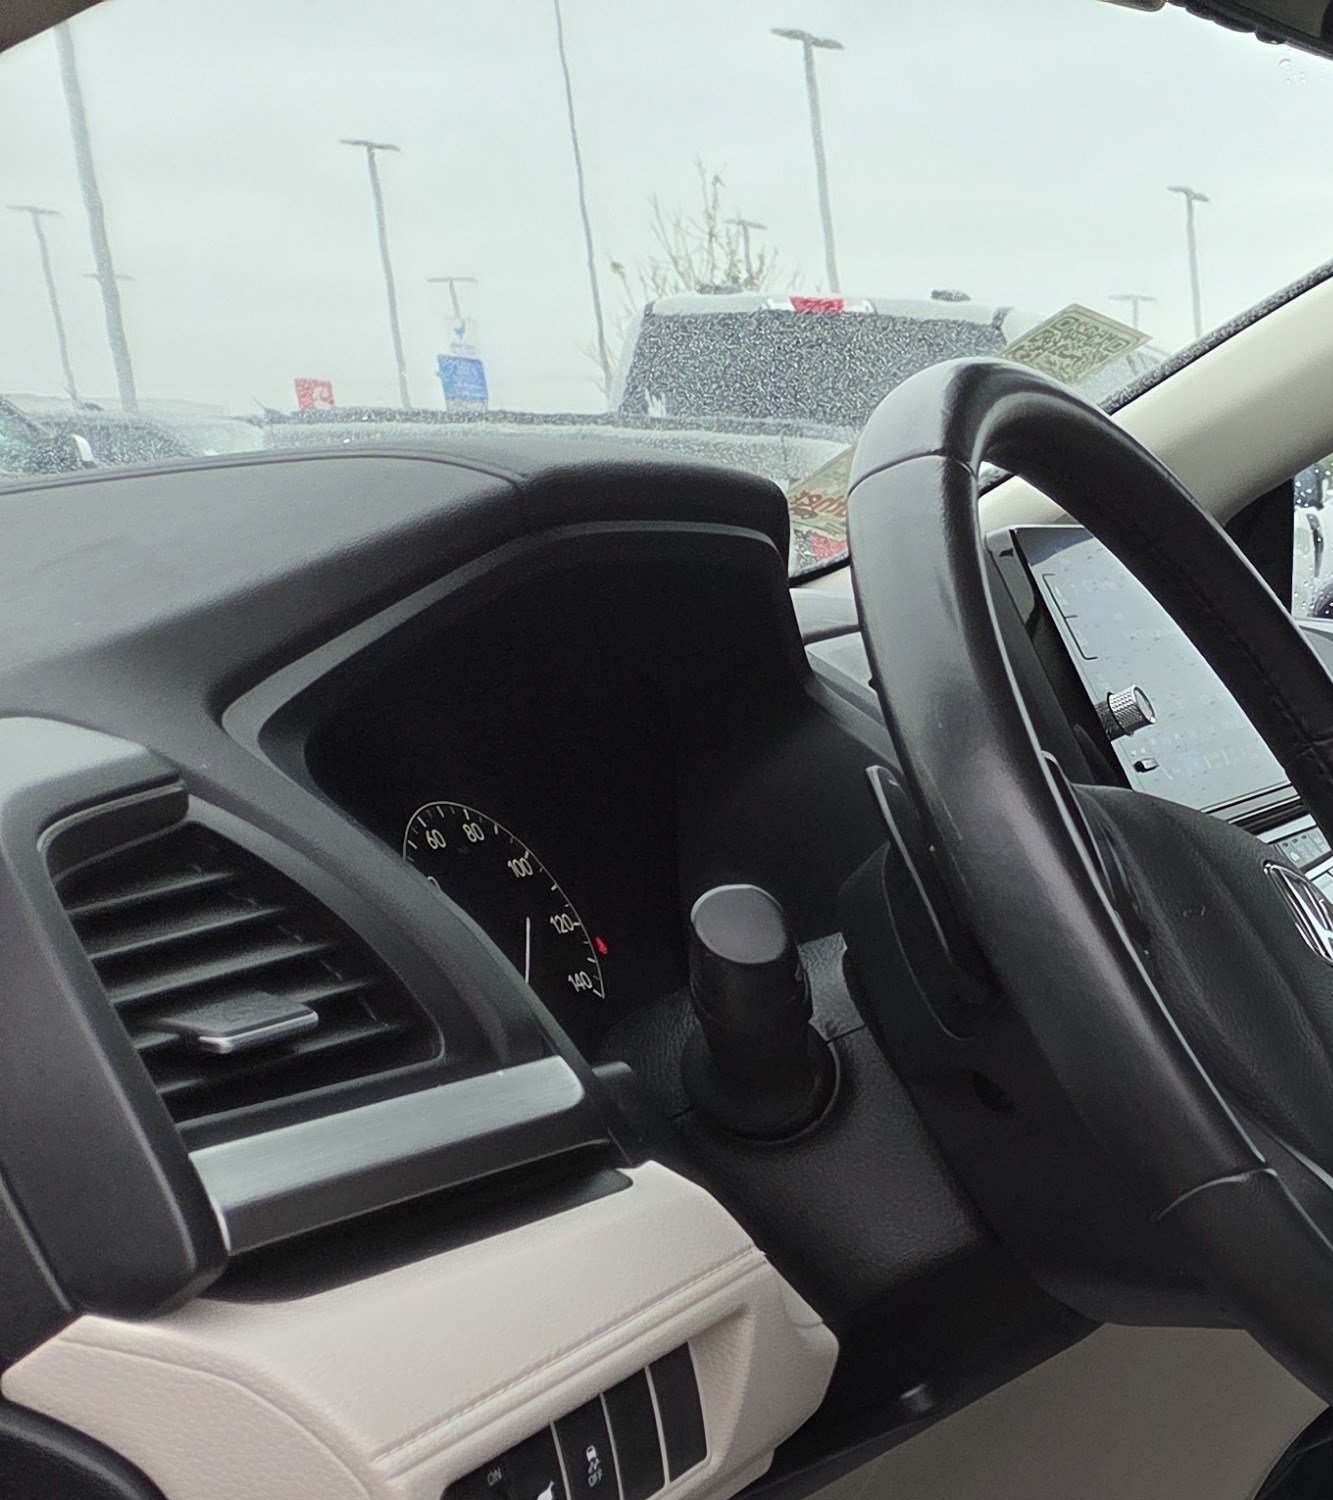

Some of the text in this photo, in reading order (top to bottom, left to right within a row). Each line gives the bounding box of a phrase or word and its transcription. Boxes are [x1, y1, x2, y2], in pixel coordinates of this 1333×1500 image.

[425, 829, 447, 850] 60
[462, 823, 485, 843] 80
[508, 857, 533, 878] 100
[550, 913, 575, 934] 120
[568, 971, 593, 992] 140
